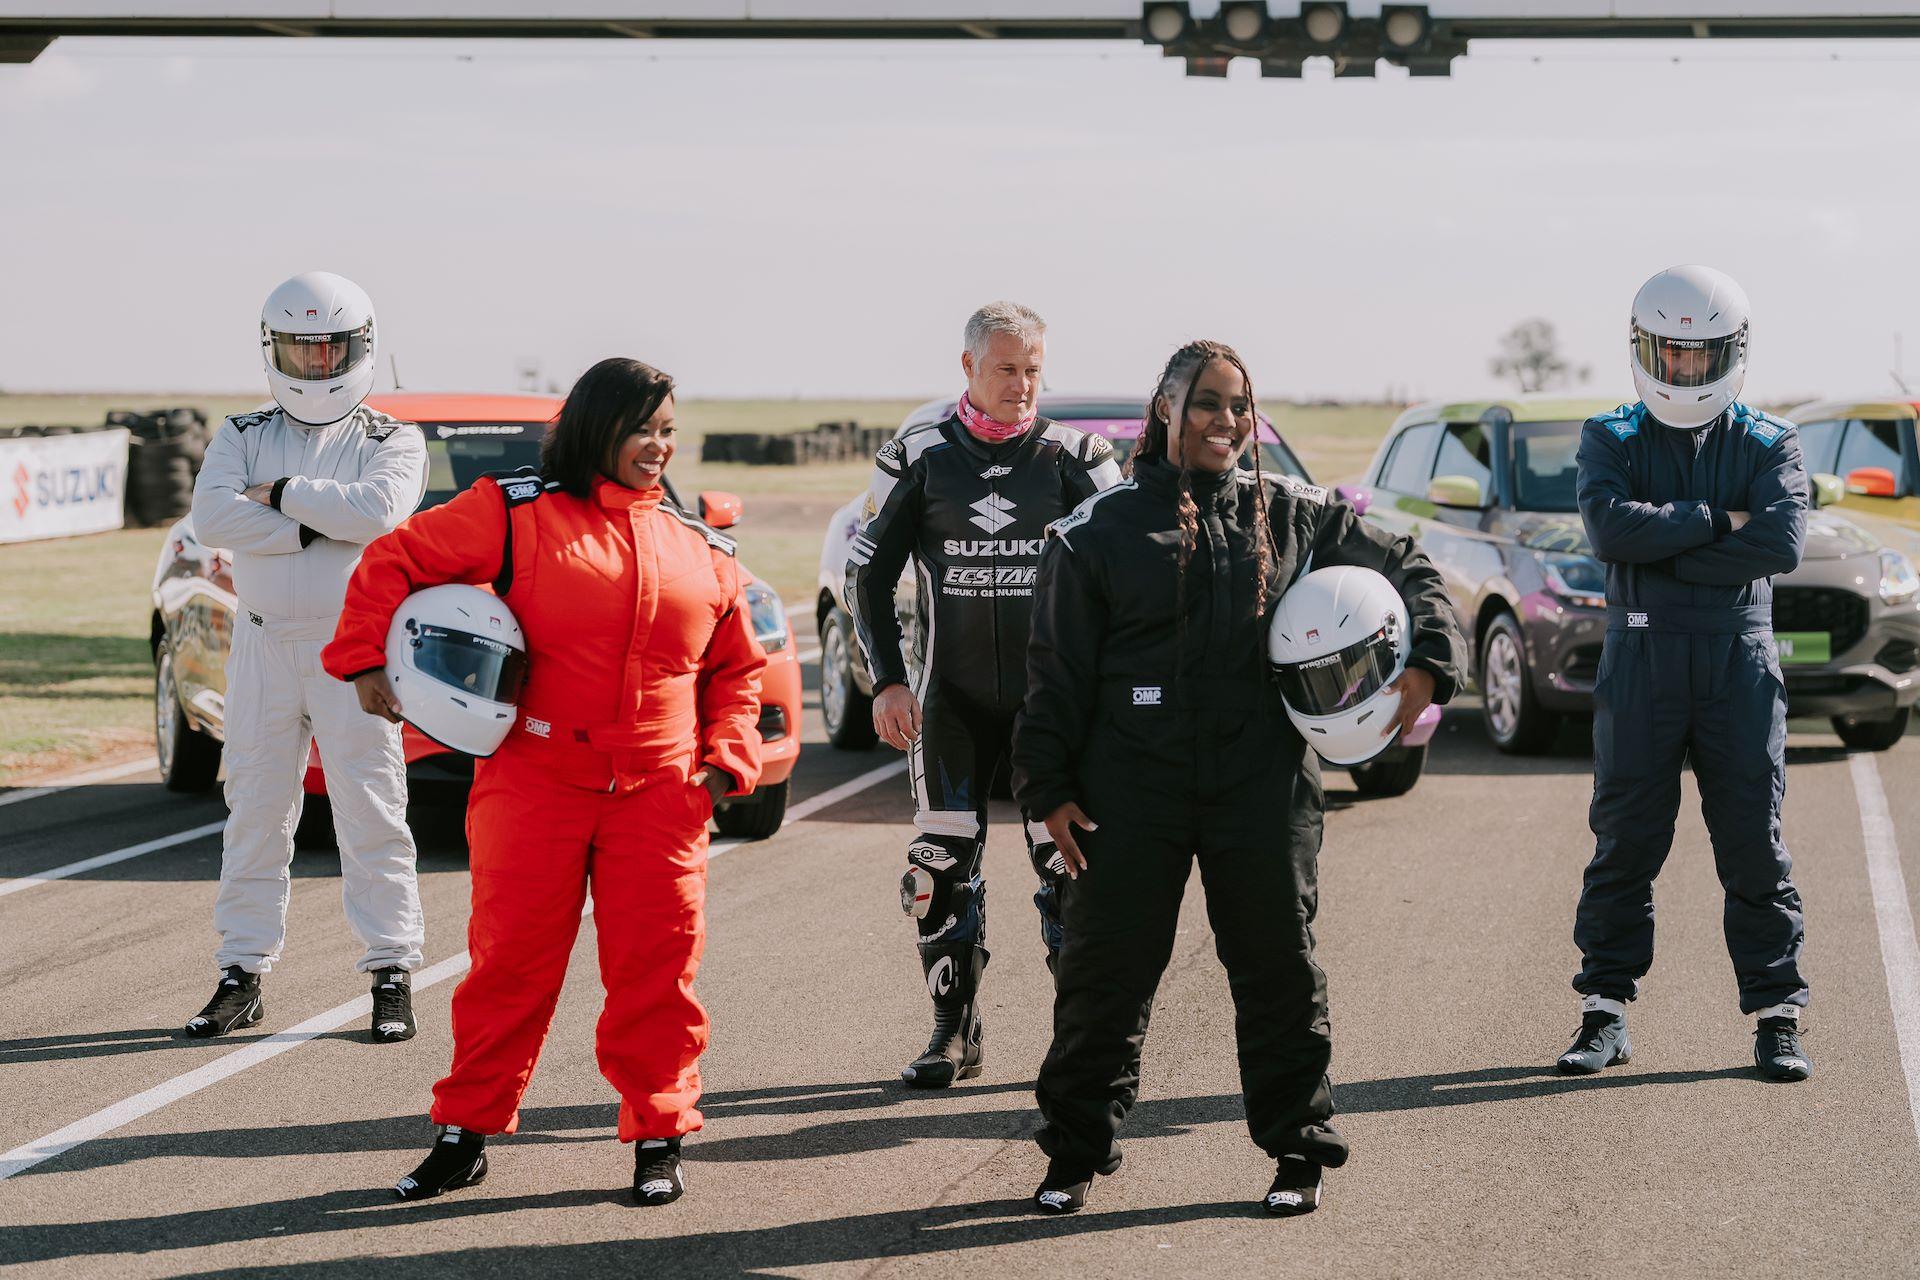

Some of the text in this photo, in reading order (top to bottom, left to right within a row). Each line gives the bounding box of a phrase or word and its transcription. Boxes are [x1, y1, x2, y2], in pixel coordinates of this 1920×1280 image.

[295, 334, 333, 342] PYROTECT
[508, 484, 538, 497] OMP
[1293, 484, 1321, 494] OMP
[1060, 511, 1086, 528] OMP
[943, 539, 1046, 557] SUZUKI
[942, 586, 1033, 598] SUZUKI GENUINE
[1627, 614, 1649, 625] OMP
[472, 636, 512, 654] PYROTECT
[1298, 652, 1341, 671] PYROTECT
[1132, 689, 1162, 702] OMP
[525, 719, 551, 735] OMP
[642, 1181, 674, 1192] OMP
[1038, 1192, 1069, 1204] OMP
[1267, 1193, 1303, 1204] OMP
